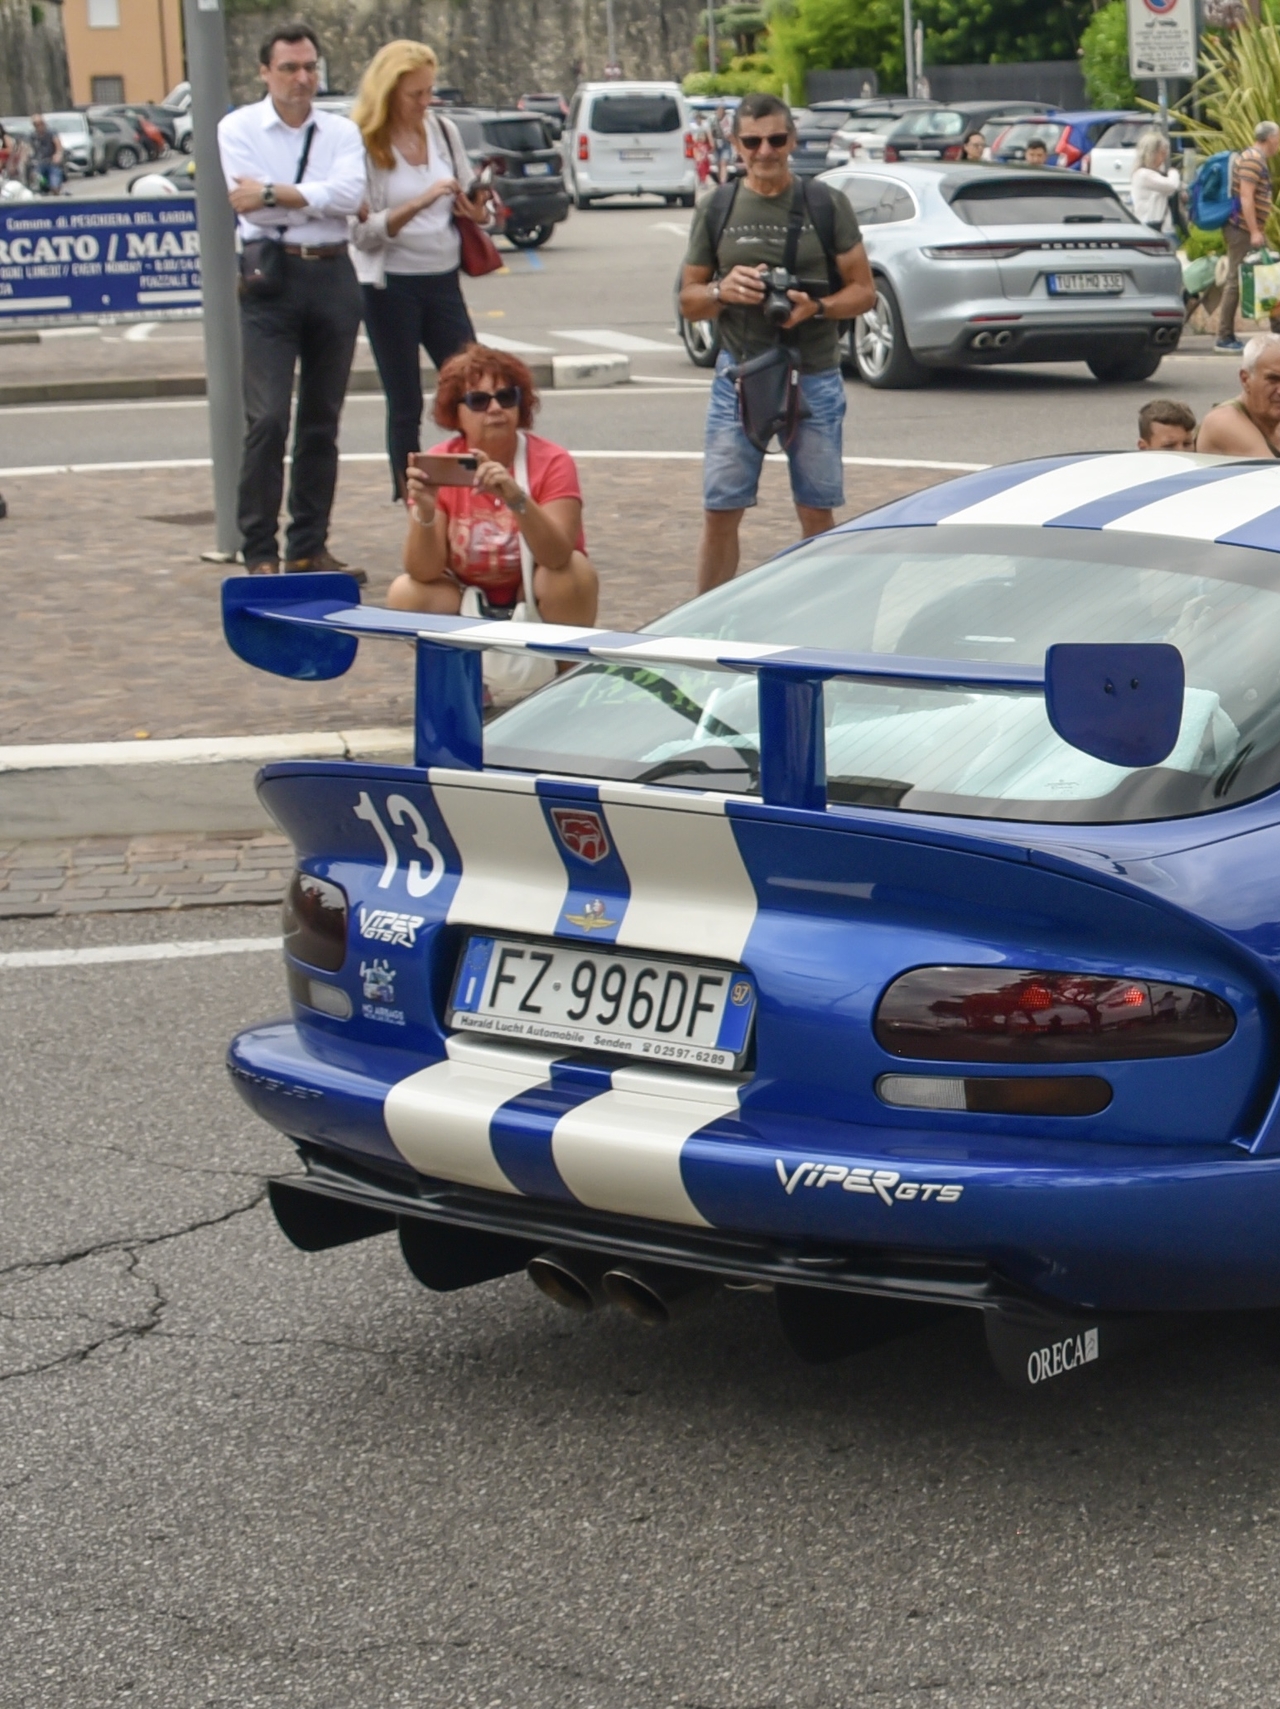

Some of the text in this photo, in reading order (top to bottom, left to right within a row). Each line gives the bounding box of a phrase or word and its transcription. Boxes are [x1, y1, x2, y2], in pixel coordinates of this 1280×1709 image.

[6, 210, 196, 232] Comune di PESCHIERA DEL GARDA
[106, 232, 119, 262] /
[353, 791, 446, 898] 13
[489, 948, 555, 1015] FZ
[566, 959, 725, 1038] 996DF
[732, 985, 750, 1003] 97
[460, 1015, 494, 1030] Harald
[495, 1020, 525, 1035] Lucht
[526, 1023, 585, 1044] Automobile
[593, 1034, 632, 1051] Senden
[895, 1182, 965, 1204] GTS
[1027, 1333, 1085, 1385] ORECA
